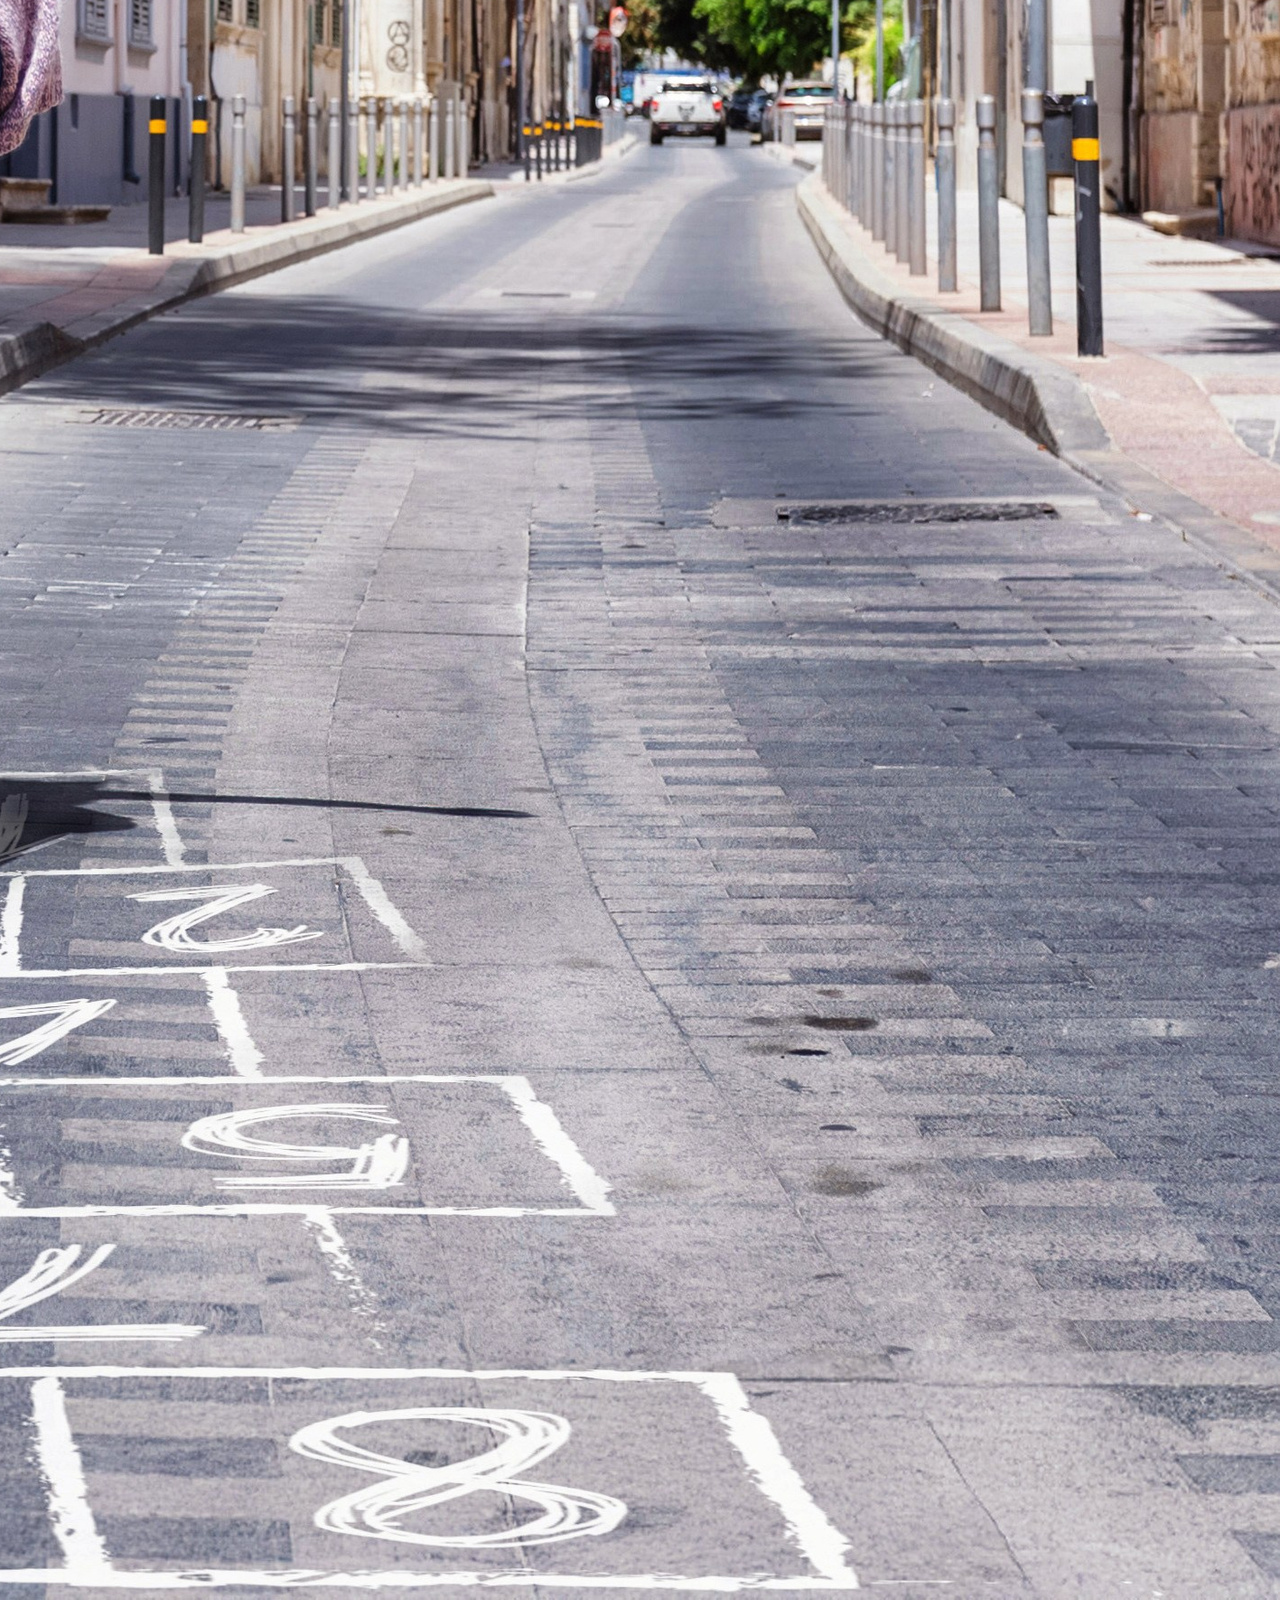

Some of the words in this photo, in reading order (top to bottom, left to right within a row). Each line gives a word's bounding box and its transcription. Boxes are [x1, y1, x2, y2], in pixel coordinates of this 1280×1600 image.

[126, 883, 324, 953] 2
[181, 1103, 408, 1189] 5
[289, 1407, 627, 1548] 8
